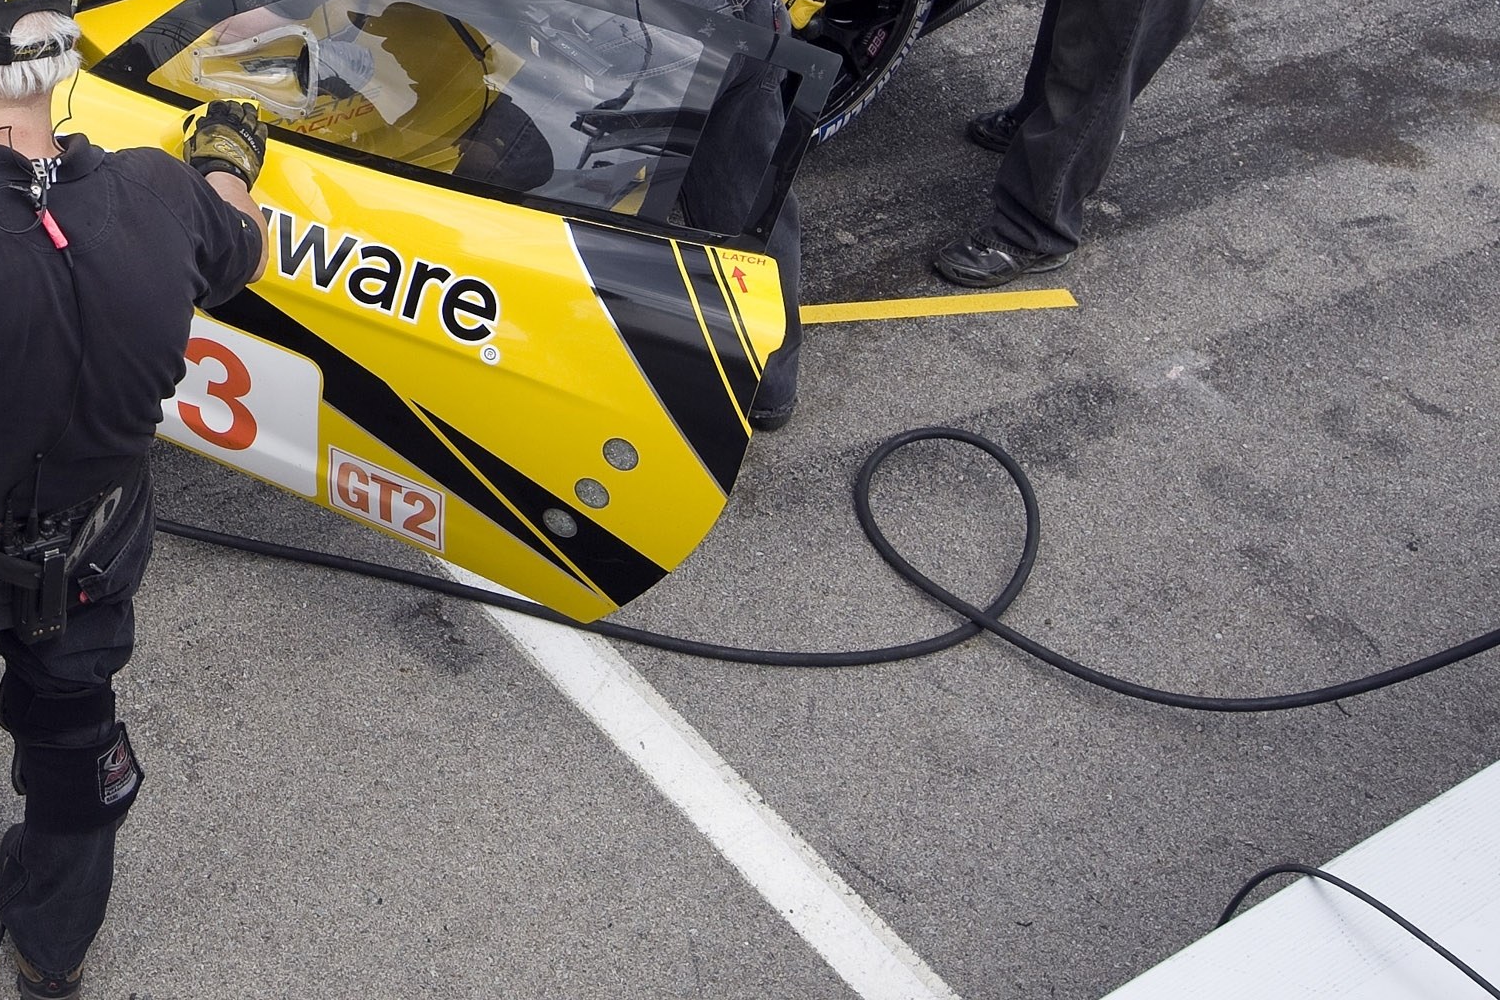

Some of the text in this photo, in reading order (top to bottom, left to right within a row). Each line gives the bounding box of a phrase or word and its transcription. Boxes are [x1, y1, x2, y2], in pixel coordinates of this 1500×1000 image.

[259, 206, 499, 344] ware
[721, 249, 768, 268] LATCH
[177, 336, 259, 451] 3
[336, 460, 441, 542] GT2
